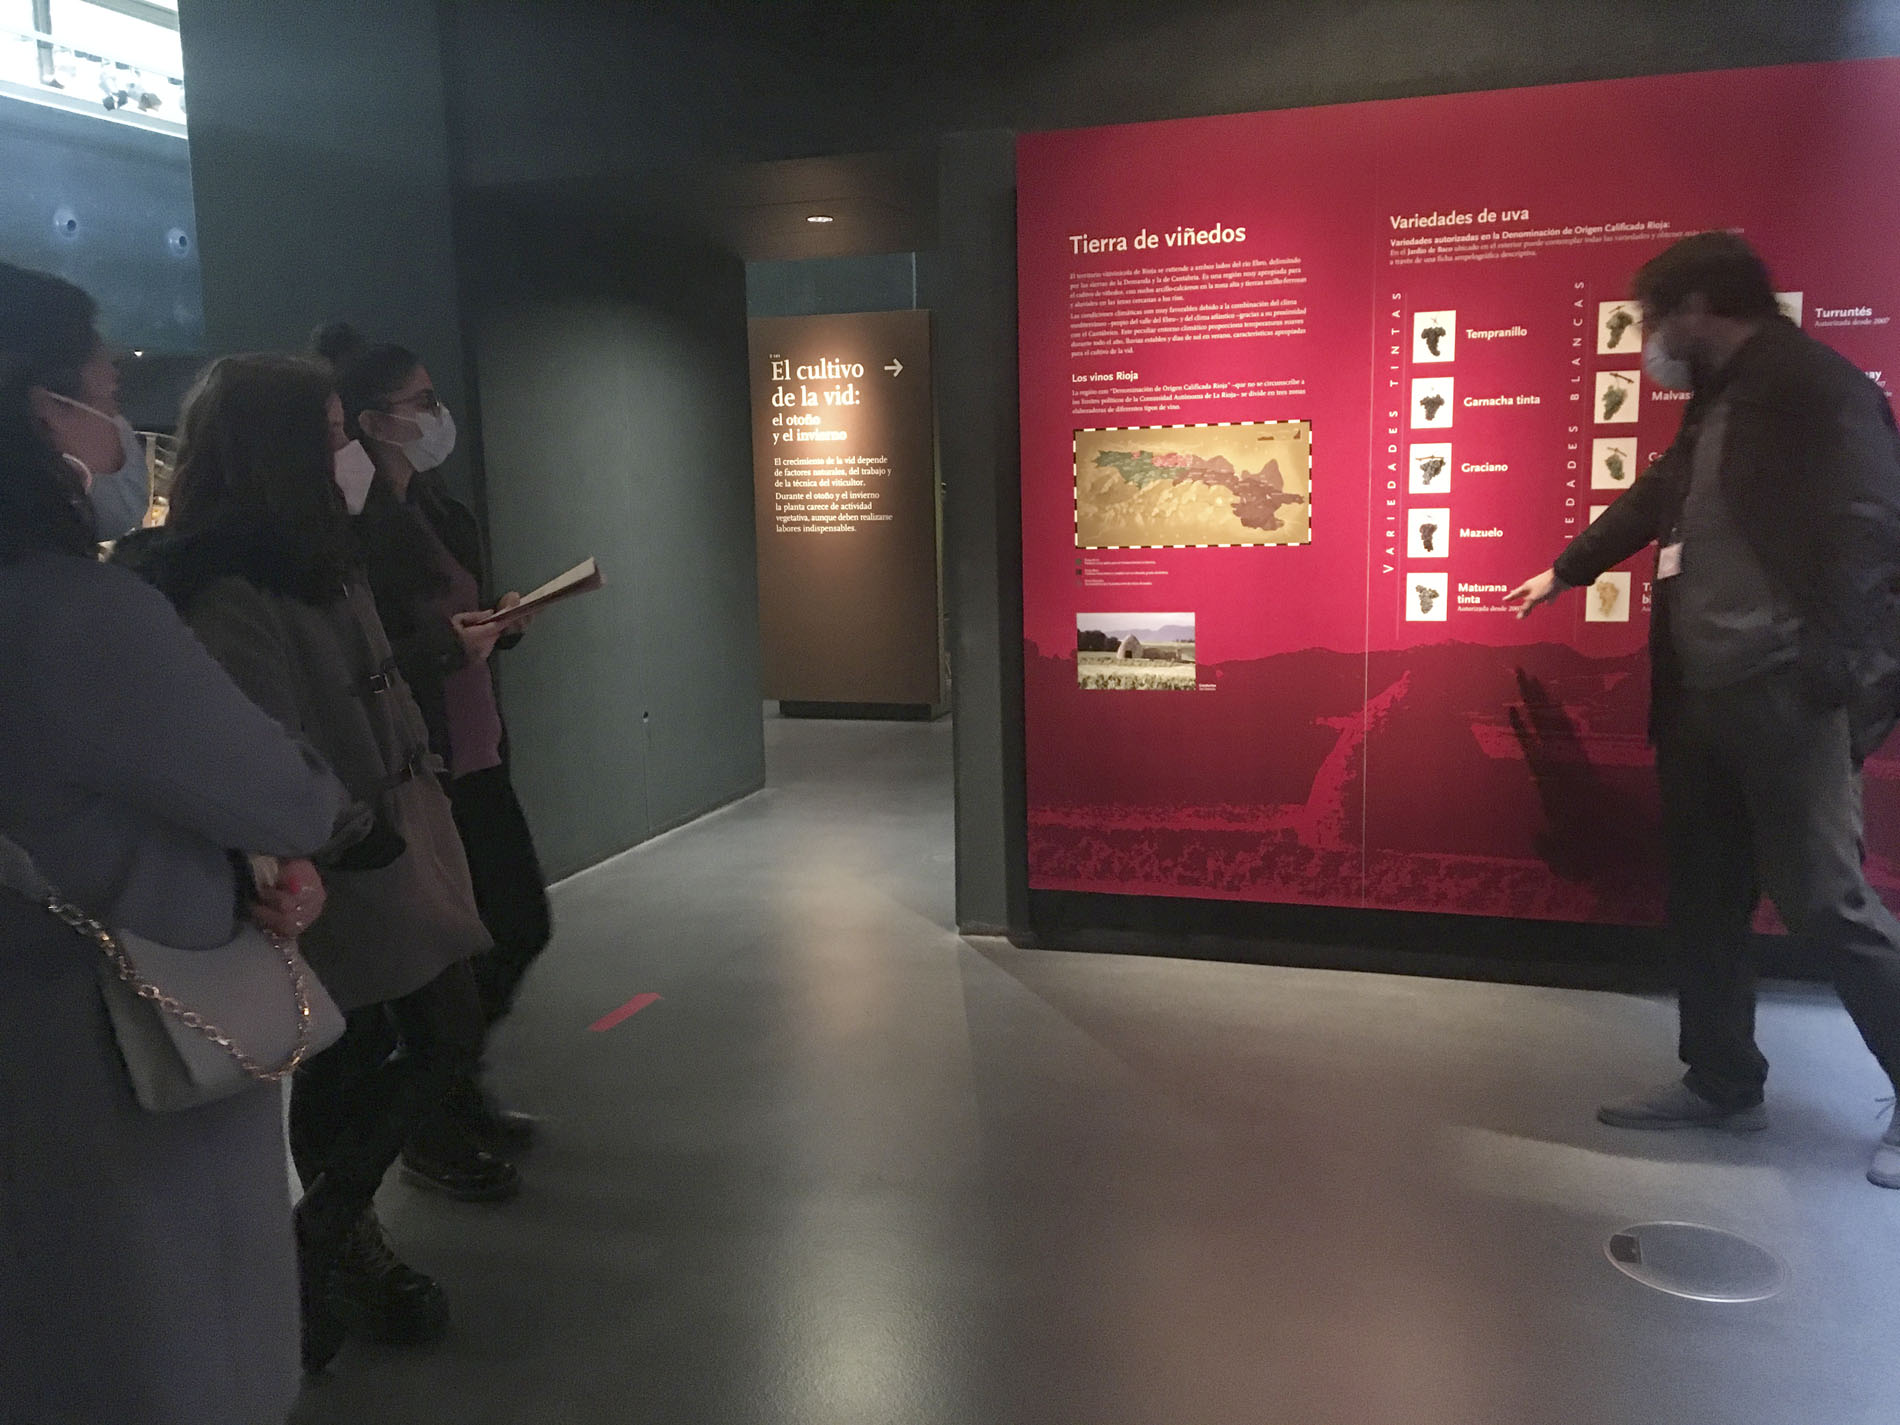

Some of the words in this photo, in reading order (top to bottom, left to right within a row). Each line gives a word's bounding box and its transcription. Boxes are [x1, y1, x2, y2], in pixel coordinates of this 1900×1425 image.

[1390, 211, 1473, 230] Variedades
[1477, 208, 1497, 223] de
[1501, 209, 1529, 222] uva
[1069, 234, 1127, 254] Tierra
[1134, 229, 1159, 250] de
[1165, 223, 1246, 246] viñedos
[1390, 237, 1433, 247] Variedades
[1434, 234, 1479, 244] autorizadas
[1492, 232, 1500, 240] la
[1501, 229, 1561, 239] Denominación
[1562, 226, 1573, 235] de
[1574, 226, 1603, 236] Origen
[1604, 222, 1645, 232] Calificada
[1647, 221, 1671, 230] Rioja:
[1815, 306, 1872, 318] Turruntés
[1466, 326, 1528, 340] Tempranillo
[1570, 282, 1584, 400] BLANCAS
[771, 359, 790, 381] El
[796, 358, 864, 380] cultivo
[1072, 374, 1088, 383] Los
[1089, 372, 1114, 382] vinos
[1116, 370, 1139, 382] Rioja
[772, 386, 795, 407] de
[801, 385, 819, 407] la
[823, 383, 860, 406] vid:
[1464, 395, 1513, 407] Garnacha
[1516, 394, 1540, 405] tinta
[1652, 390, 1694, 400] Malvasi
[772, 413, 783, 426] el
[786, 414, 820, 426] otoño
[773, 433, 780, 446] y
[782, 428, 793, 442] el
[796, 428, 848, 442] invierno
[1382, 410, 1398, 574] VARIEDADES
[1390, 292, 1402, 387] TINTAS
[774, 457, 782, 466] El
[825, 456, 835, 465] de
[836, 455, 843, 465] la
[844, 455, 856, 465] vid
[857, 455, 888, 466] depende
[774, 468, 783, 477] de
[784, 468, 812, 477] factores
[848, 466, 860, 475] del
[861, 466, 886, 476] trabajo
[887, 468, 892, 477] y
[1461, 462, 1508, 472] Graciano
[774, 479, 784, 488] de
[784, 479, 792, 487] la
[792, 479, 818, 487] técnica
[818, 478, 830, 487] del
[831, 478, 867, 487] viticultor.
[1564, 425, 1578, 538] IEDADES
[805, 491, 813, 500] el
[813, 492, 834, 500] otoño
[835, 493, 840, 502] y
[841, 490, 848, 500] el
[849, 491, 880, 499] invierno
[775, 503, 782, 511] la
[783, 502, 805, 513] planta
[830, 502, 839, 511] de
[840, 501, 872, 510] actividad
[811, 515, 837, 523] aunque
[837, 512, 859, 521] deben
[860, 512, 893, 521] realizarse
[776, 524, 802, 532] labores
[1459, 528, 1504, 538] Mazuelo
[1458, 583, 1508, 592] Maturana
[1457, 594, 1480, 604] tinta
